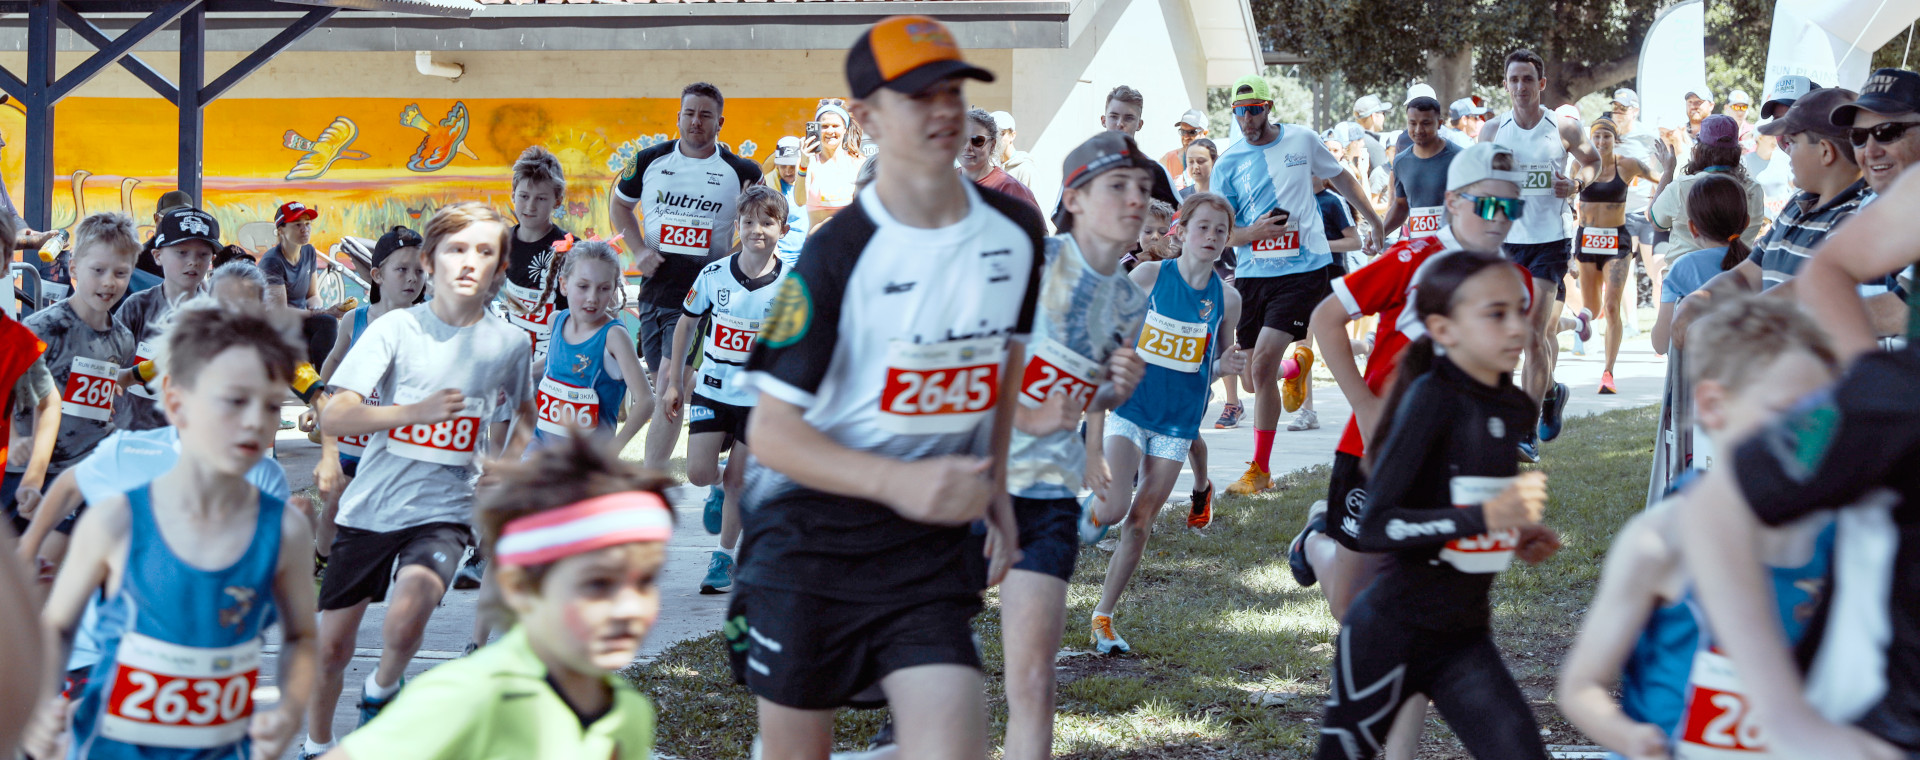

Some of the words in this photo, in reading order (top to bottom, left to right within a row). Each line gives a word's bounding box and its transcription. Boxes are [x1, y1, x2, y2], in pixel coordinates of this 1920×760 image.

[655, 206, 664, 217] Ag
[656, 189, 723, 214] Nutrien
[663, 226, 708, 247] 2684
[1257, 232, 1295, 251] 2647
[1585, 235, 1616, 249] 2699
[729, 318, 744, 326] PLAINS
[719, 327, 757, 351] 267
[1144, 329, 1198, 361] 2513
[71, 376, 113, 407] 269
[548, 384, 563, 394] PLAINS
[889, 367, 991, 413] 2645
[538, 394, 592, 428] 2606
[394, 418, 473, 450] 2688
[119, 671, 250, 725] 2630
[1701, 694, 1762, 748] 26
